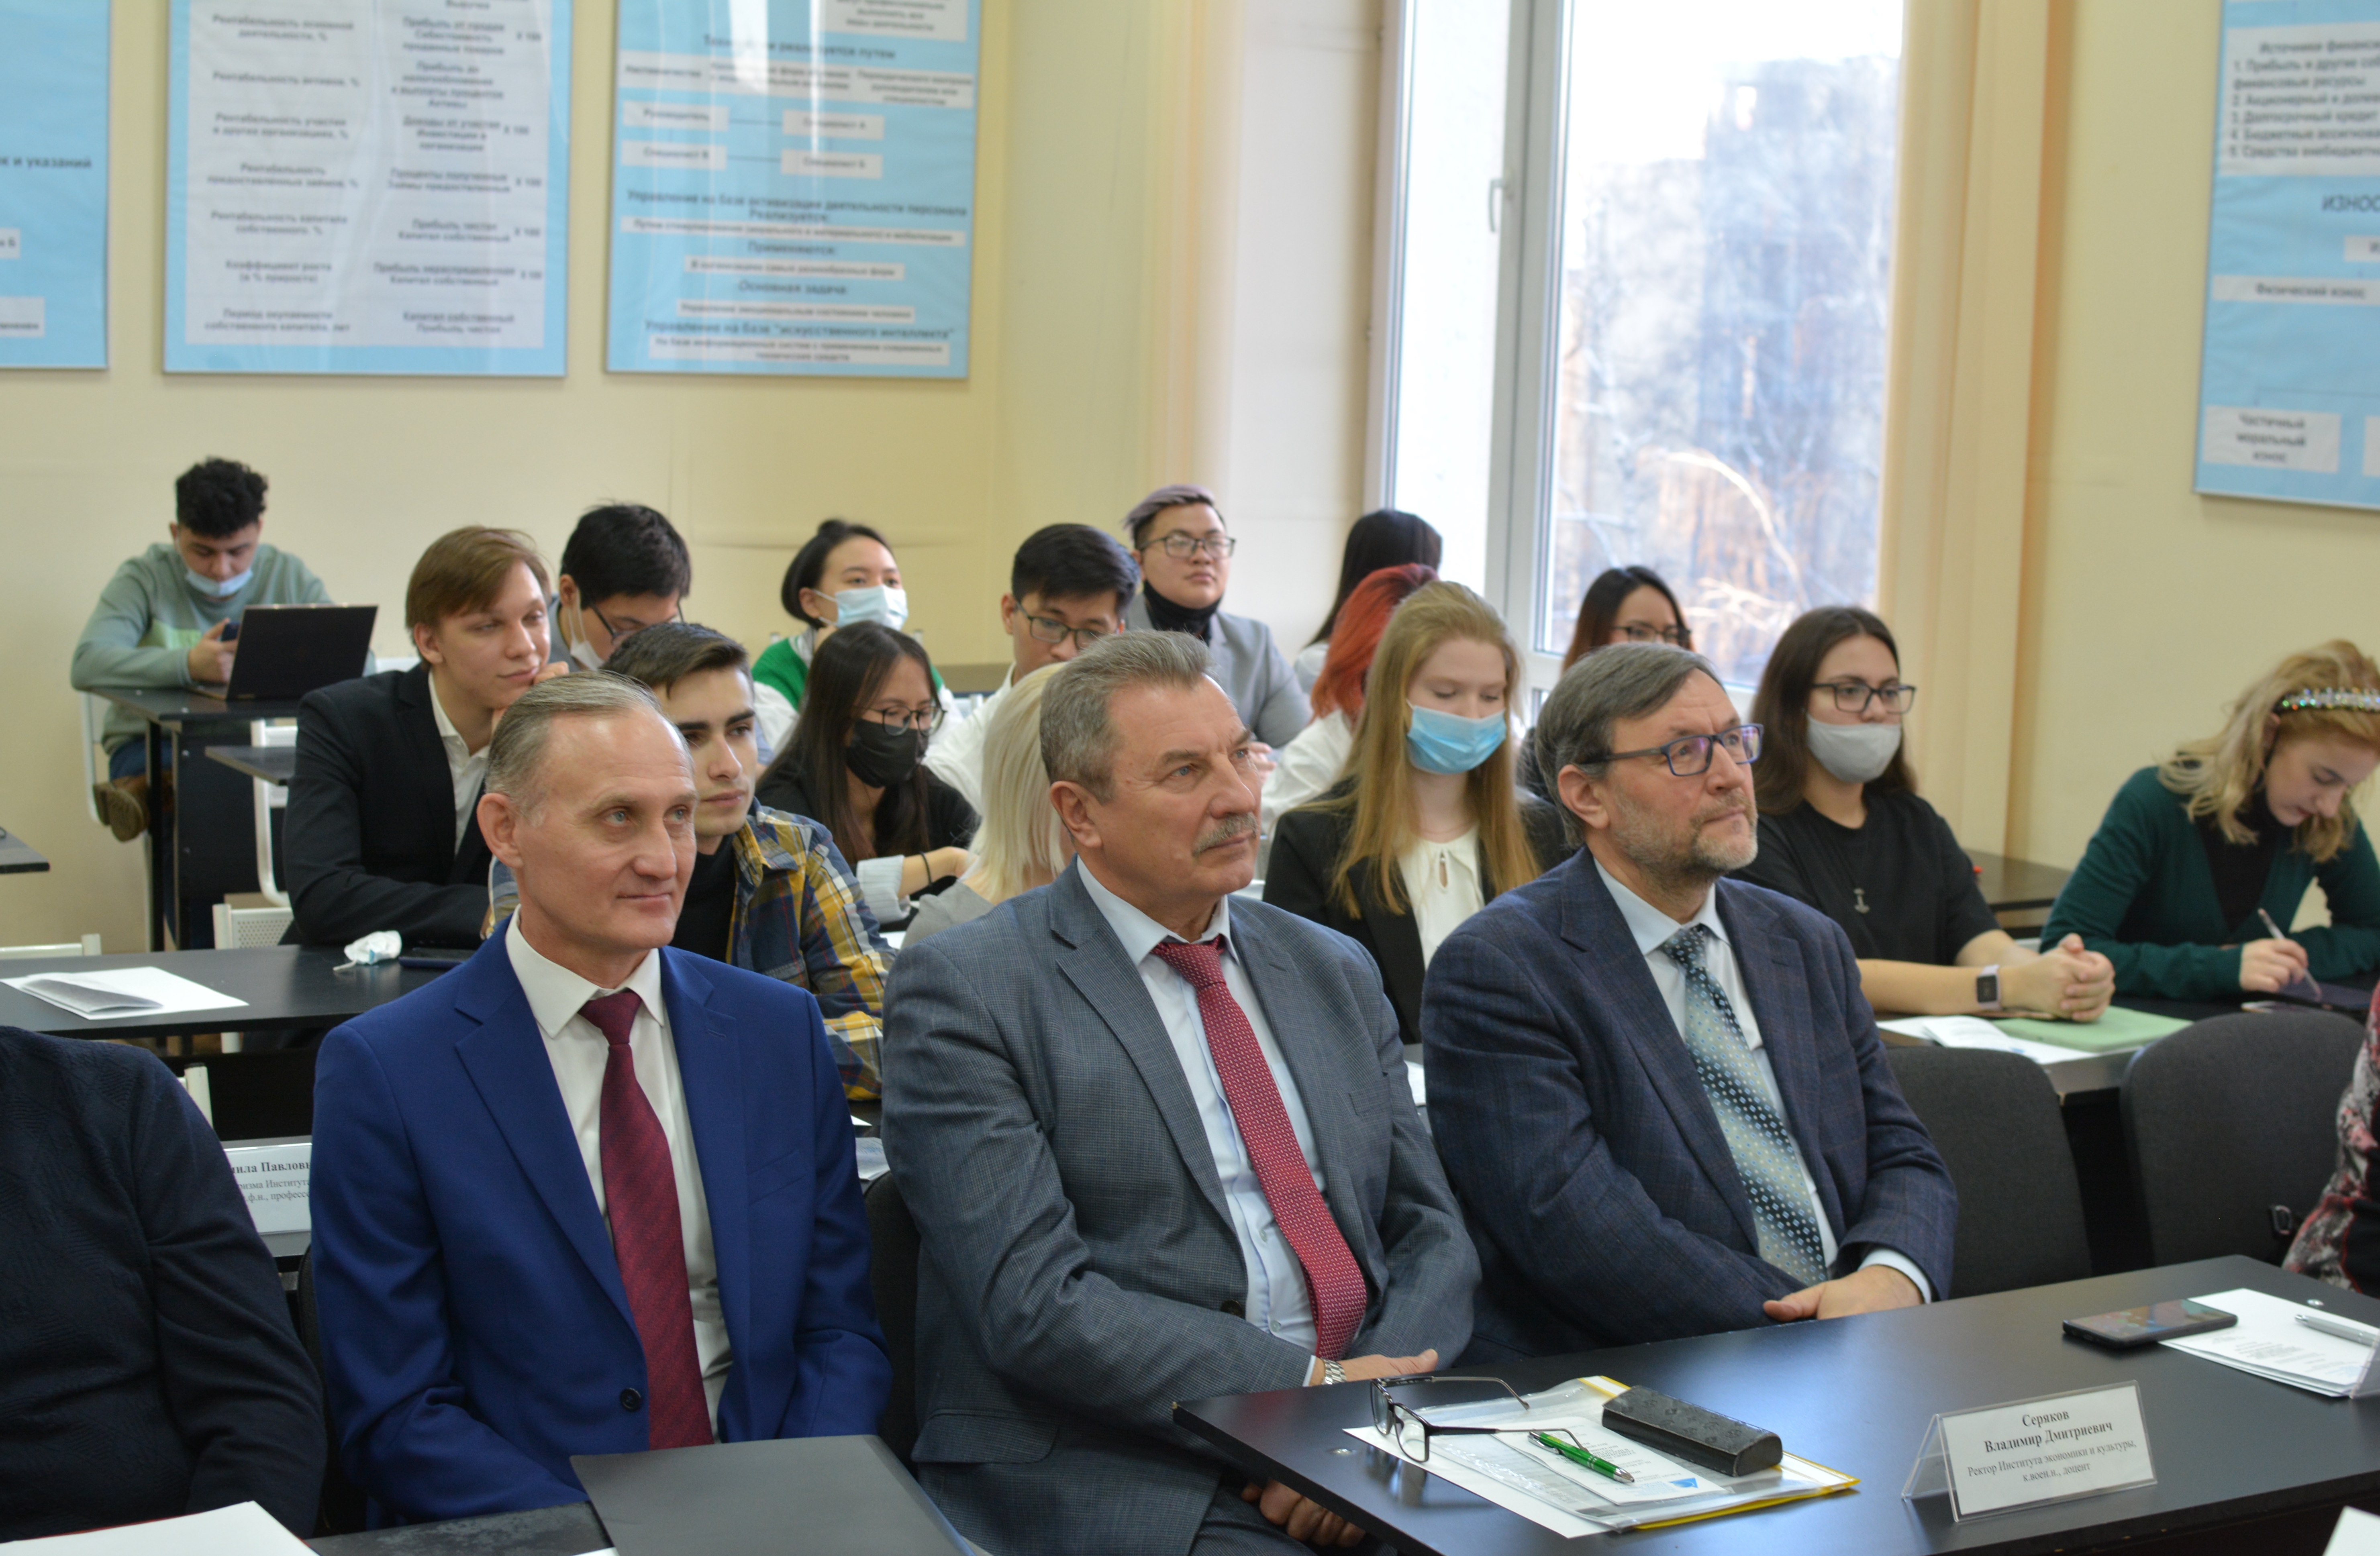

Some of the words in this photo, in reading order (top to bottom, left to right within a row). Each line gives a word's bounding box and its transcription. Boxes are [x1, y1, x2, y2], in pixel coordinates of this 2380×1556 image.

[2022, 1410, 2070, 1428] Серяков
[1984, 1434, 2042, 1453] Владимир
[2045, 1422, 2113, 1443] Дмитриевич
[1968, 1464, 1997, 1477] Ректор
[1998, 1456, 2043, 1471] Института
[2044, 1449, 2088, 1463] экономики
[2097, 1440, 2136, 1454] культуры,
[2063, 1462, 2091, 1475] доцент
